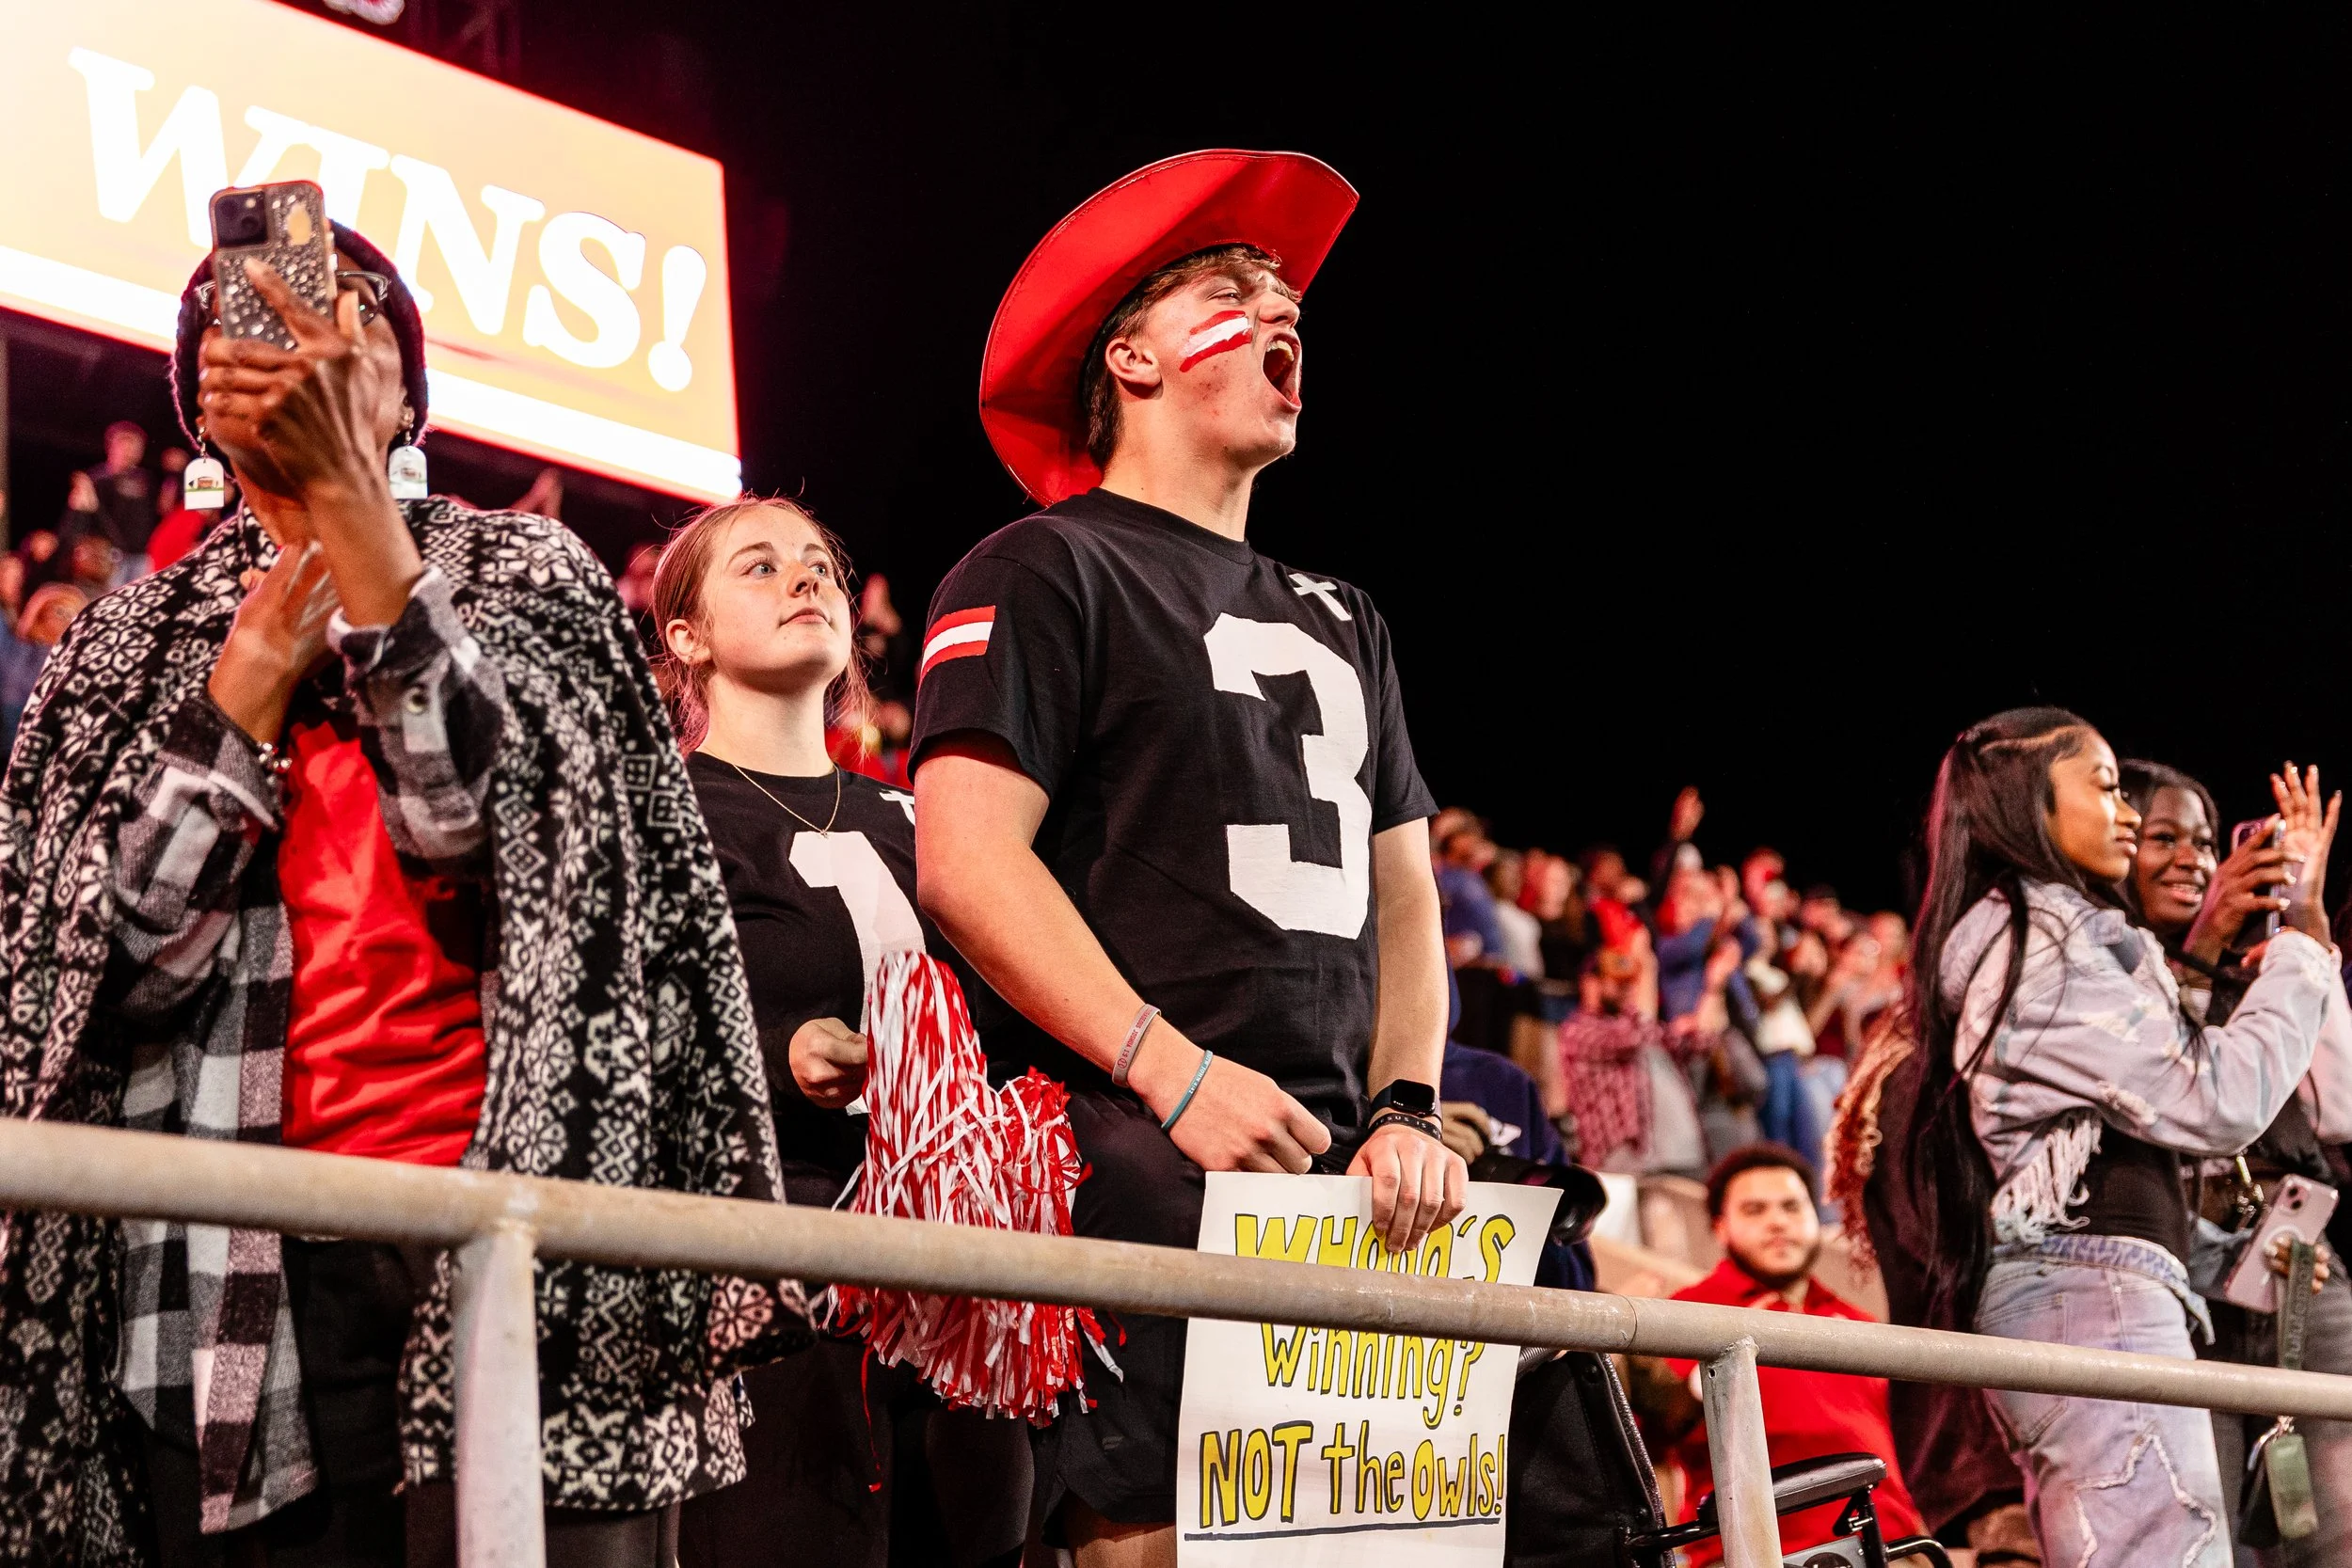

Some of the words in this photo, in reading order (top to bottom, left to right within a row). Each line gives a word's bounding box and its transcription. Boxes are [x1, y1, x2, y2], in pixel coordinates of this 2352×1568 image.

[69, 47, 707, 391] WINS!
[1204, 612, 1374, 939] 3
[1235, 1212, 1516, 1283] WHOO'S
[1200, 1419, 1314, 1528] NOT
[1321, 1419, 1405, 1514] the
